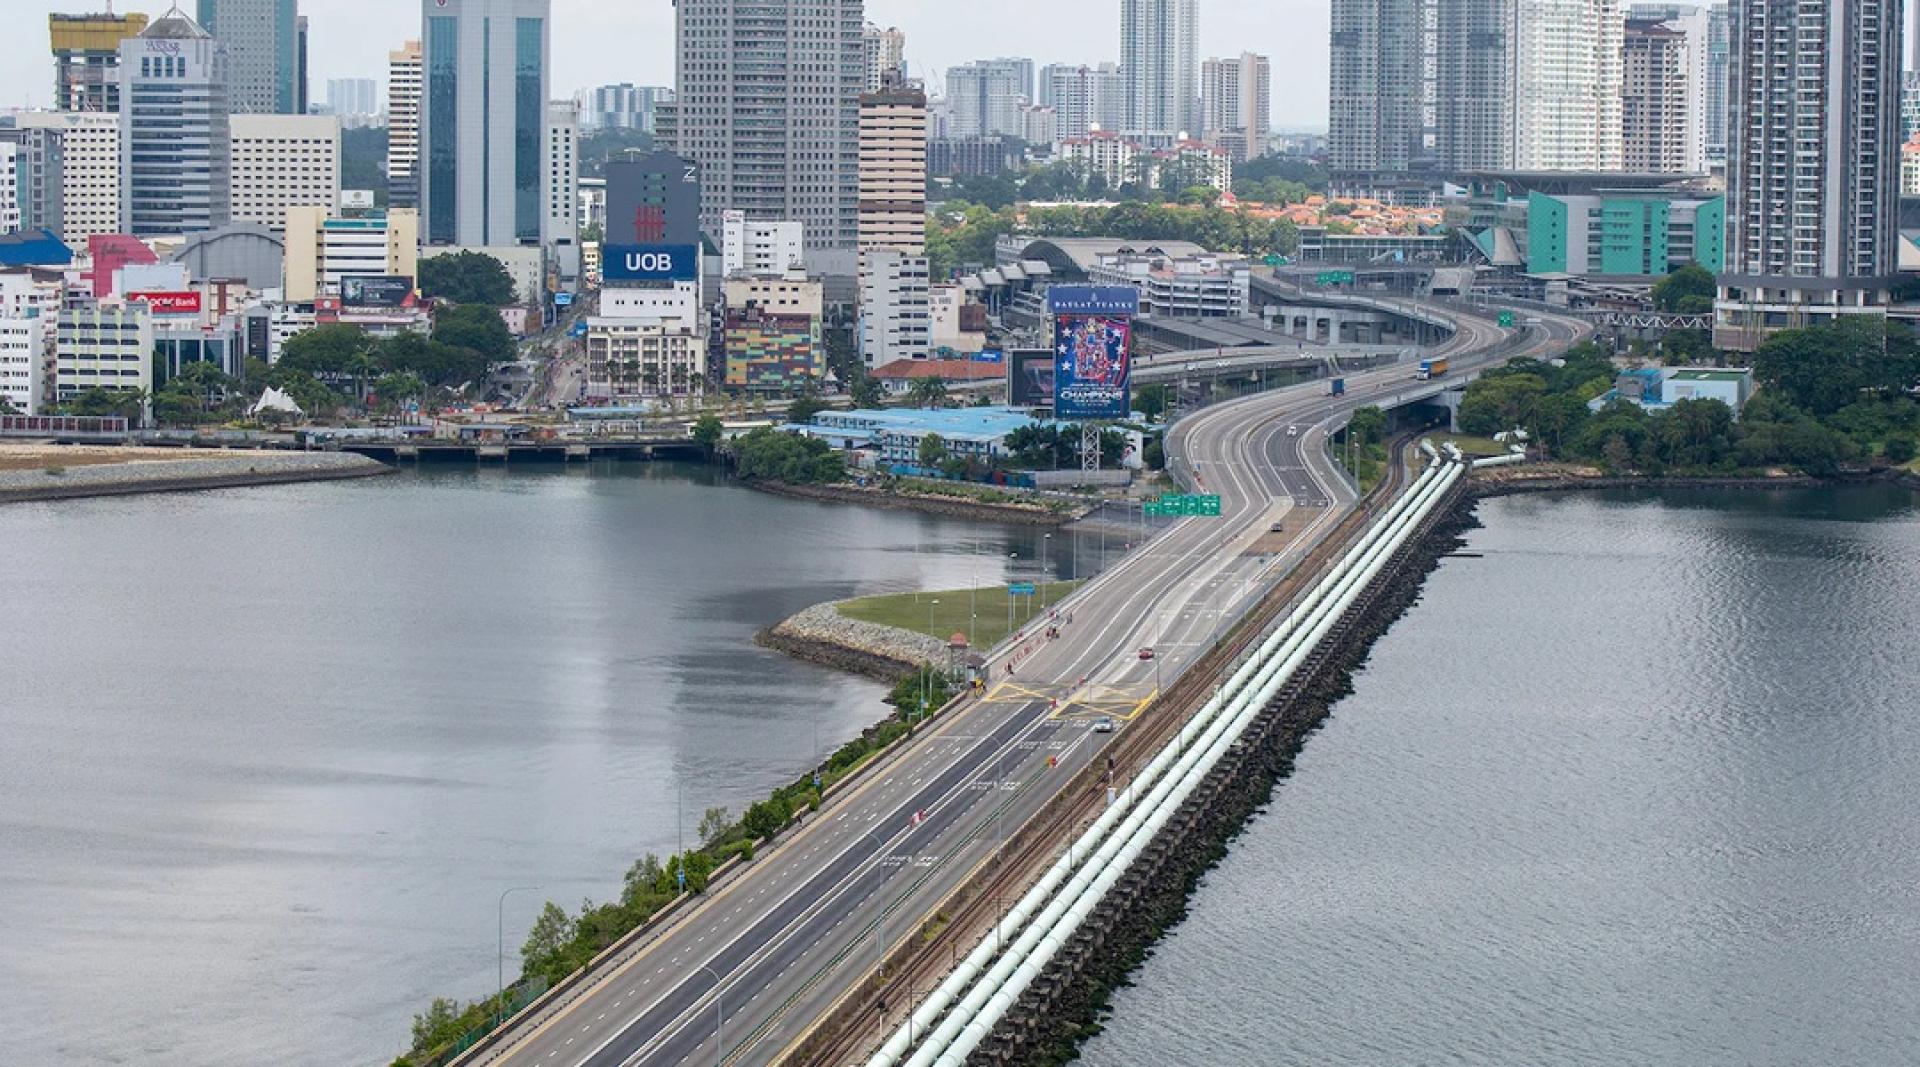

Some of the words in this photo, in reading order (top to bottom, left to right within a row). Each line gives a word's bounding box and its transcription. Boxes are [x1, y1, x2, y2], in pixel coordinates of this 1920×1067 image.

[626, 253, 672, 271] UOB
[175, 296, 197, 307] Bank
[1061, 390, 1123, 401] CHAMPIONS
